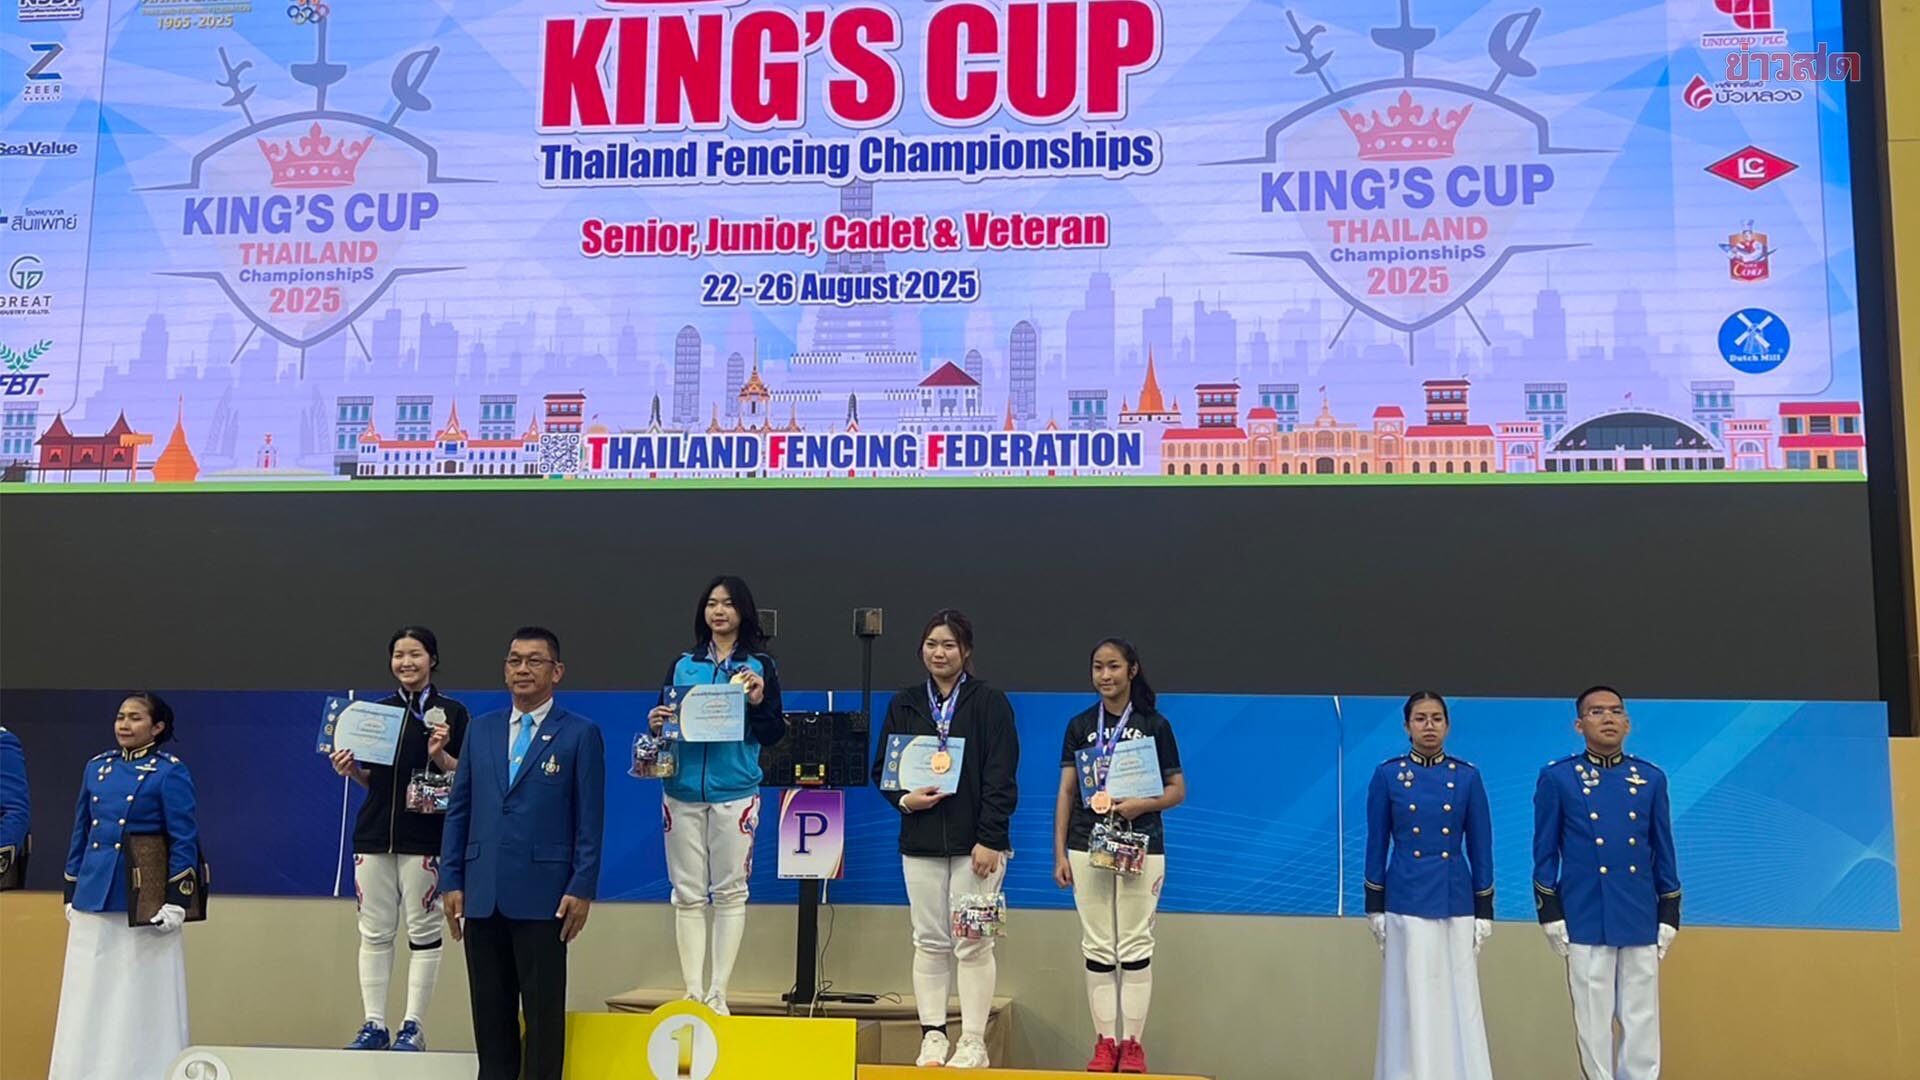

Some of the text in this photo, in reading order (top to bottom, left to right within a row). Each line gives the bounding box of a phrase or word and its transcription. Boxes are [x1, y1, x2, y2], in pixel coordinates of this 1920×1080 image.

[926, 0, 1155, 120] CUP
[24, 84, 61, 94] ZEER
[541, 131, 1154, 180] Thailand Fencing Championships
[1737, 157, 1766, 179] LC
[1446, 164, 1555, 207] CUP
[344, 192, 440, 232] CUP
[1327, 216, 1488, 243] THAILAND
[582, 213, 1106, 255] Senior, Junior, Cadet & Veteran
[239, 241, 378, 265] THAILAND
[703, 274, 737, 302] 22
[758, 273, 793, 301] 26
[800, 272, 899, 303] August
[904, 270, 976, 299] 2025
[1367, 266, 1449, 295] 2025
[269, 287, 341, 313] 2025
[588, 433, 1141, 470] THAILAND FENCING FEDERATION
[794, 812, 829, 854] P
[671, 1023, 694, 1077] 1
